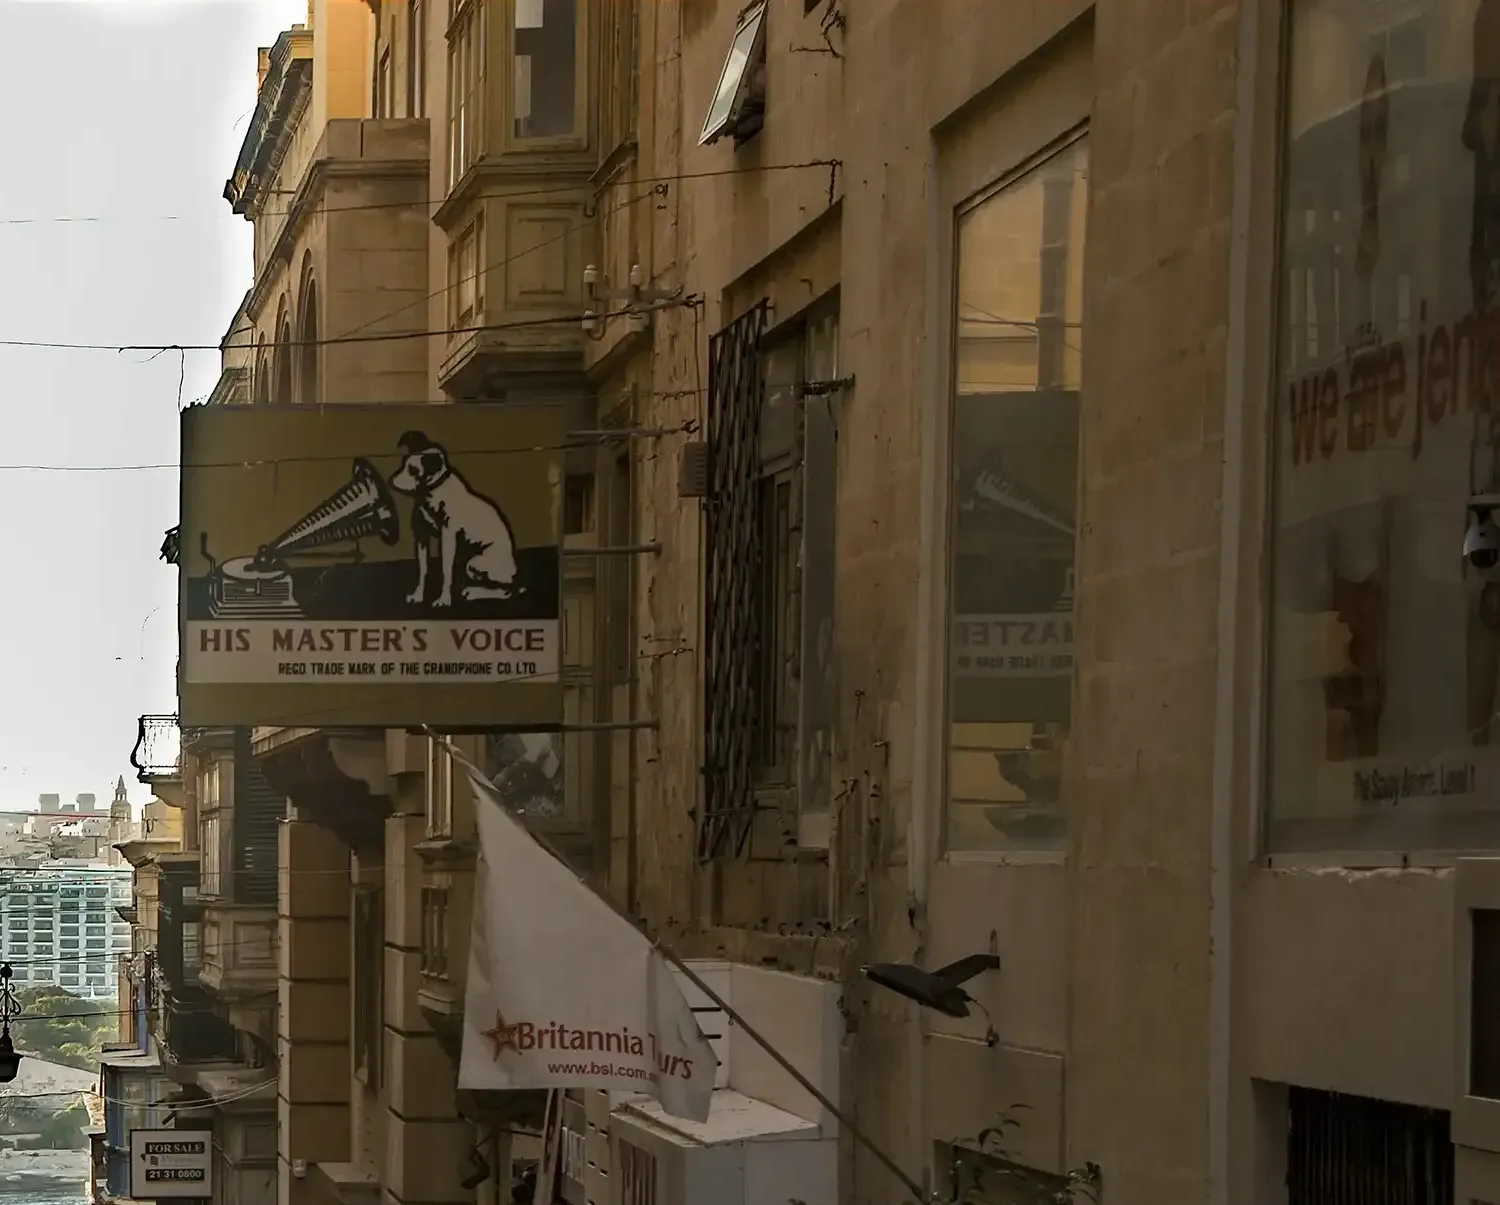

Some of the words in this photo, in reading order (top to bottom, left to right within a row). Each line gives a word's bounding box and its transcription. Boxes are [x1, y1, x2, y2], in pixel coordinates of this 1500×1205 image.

[200, 628, 250, 652] HIS
[272, 626, 428, 652] MASTER'S
[449, 628, 545, 652] VOICE
[311, 662, 345, 676] TRADE
[348, 662, 376, 676] MARK
[380, 662, 396, 675] OF
[399, 662, 420, 675] THE
[423, 661, 493, 676] GRAMOPHONE
[517, 1020, 645, 1057] Britannia
[149, 1143, 172, 1153] FOR
[174, 1143, 202, 1153] SALE
[150, 1170, 161, 1178] 21
[163, 1170, 175, 1178] 31
